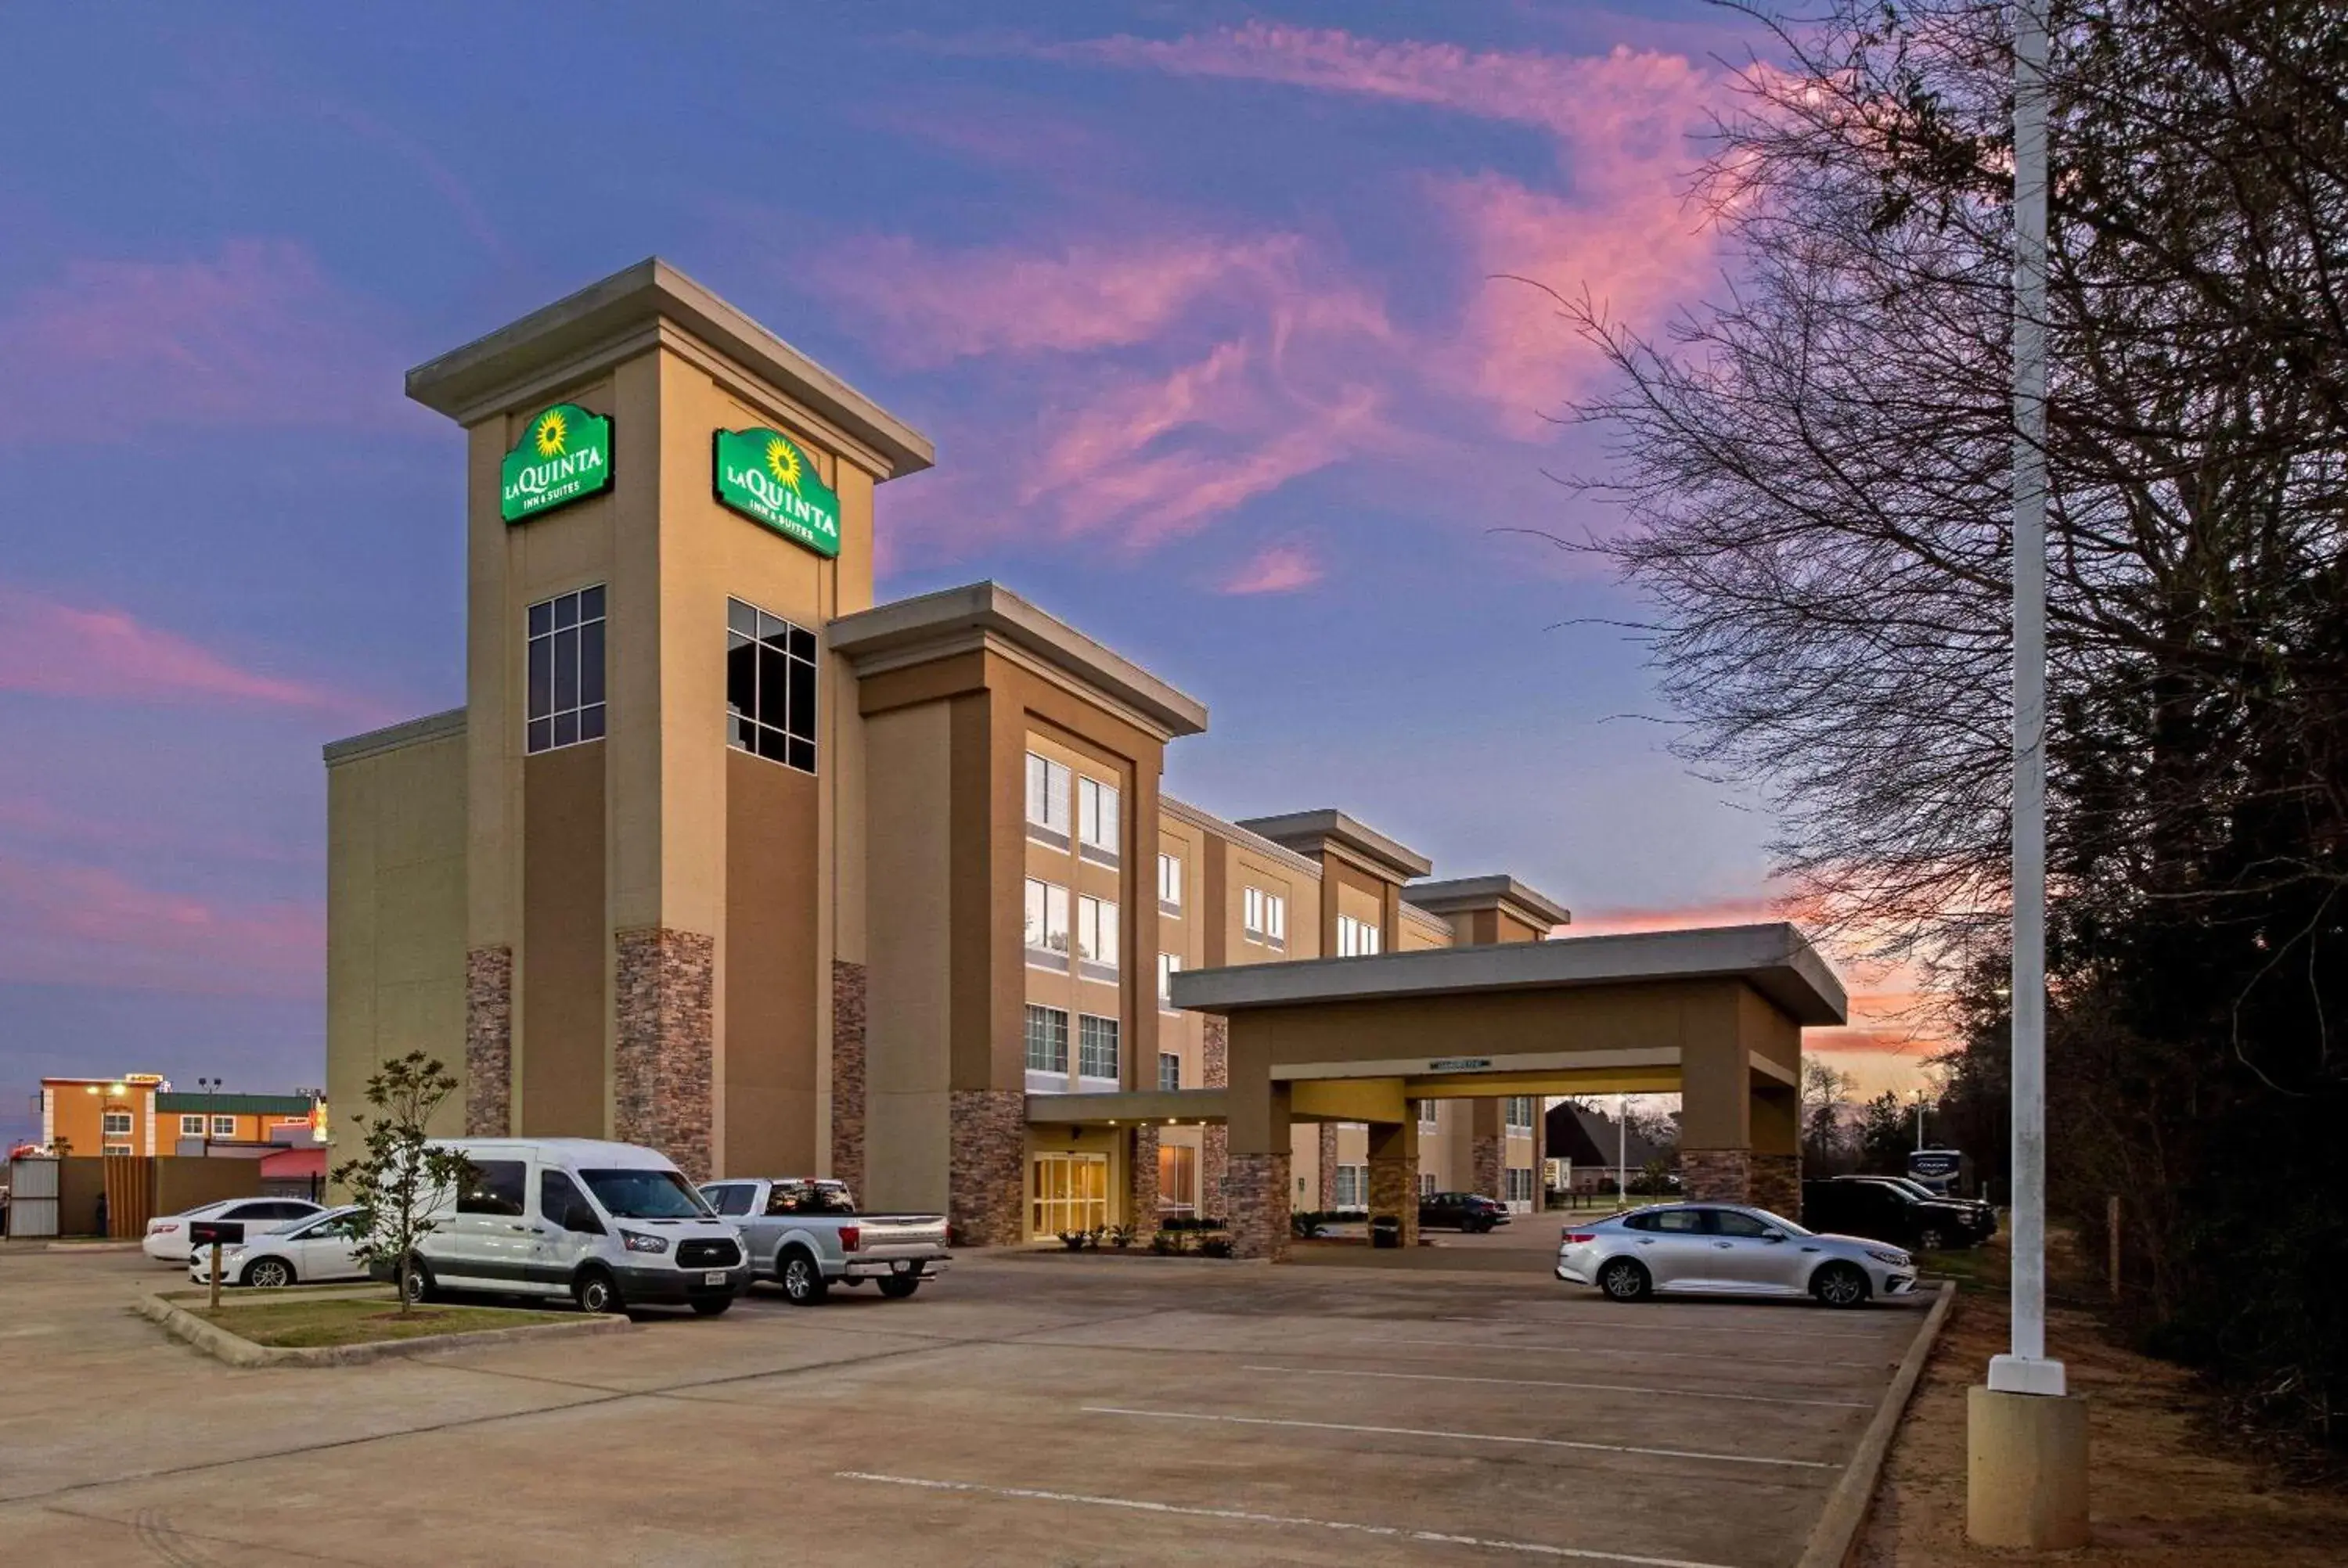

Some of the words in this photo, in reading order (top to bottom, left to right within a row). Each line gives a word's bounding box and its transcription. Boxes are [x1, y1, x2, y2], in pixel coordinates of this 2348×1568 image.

[520, 446, 602, 494] QUINTA
[524, 496, 539, 510] INN
[547, 480, 581, 501] SUITES
[746, 469, 837, 538] QUINTA
[749, 499, 769, 516] INN
[779, 515, 814, 540] SUITES
